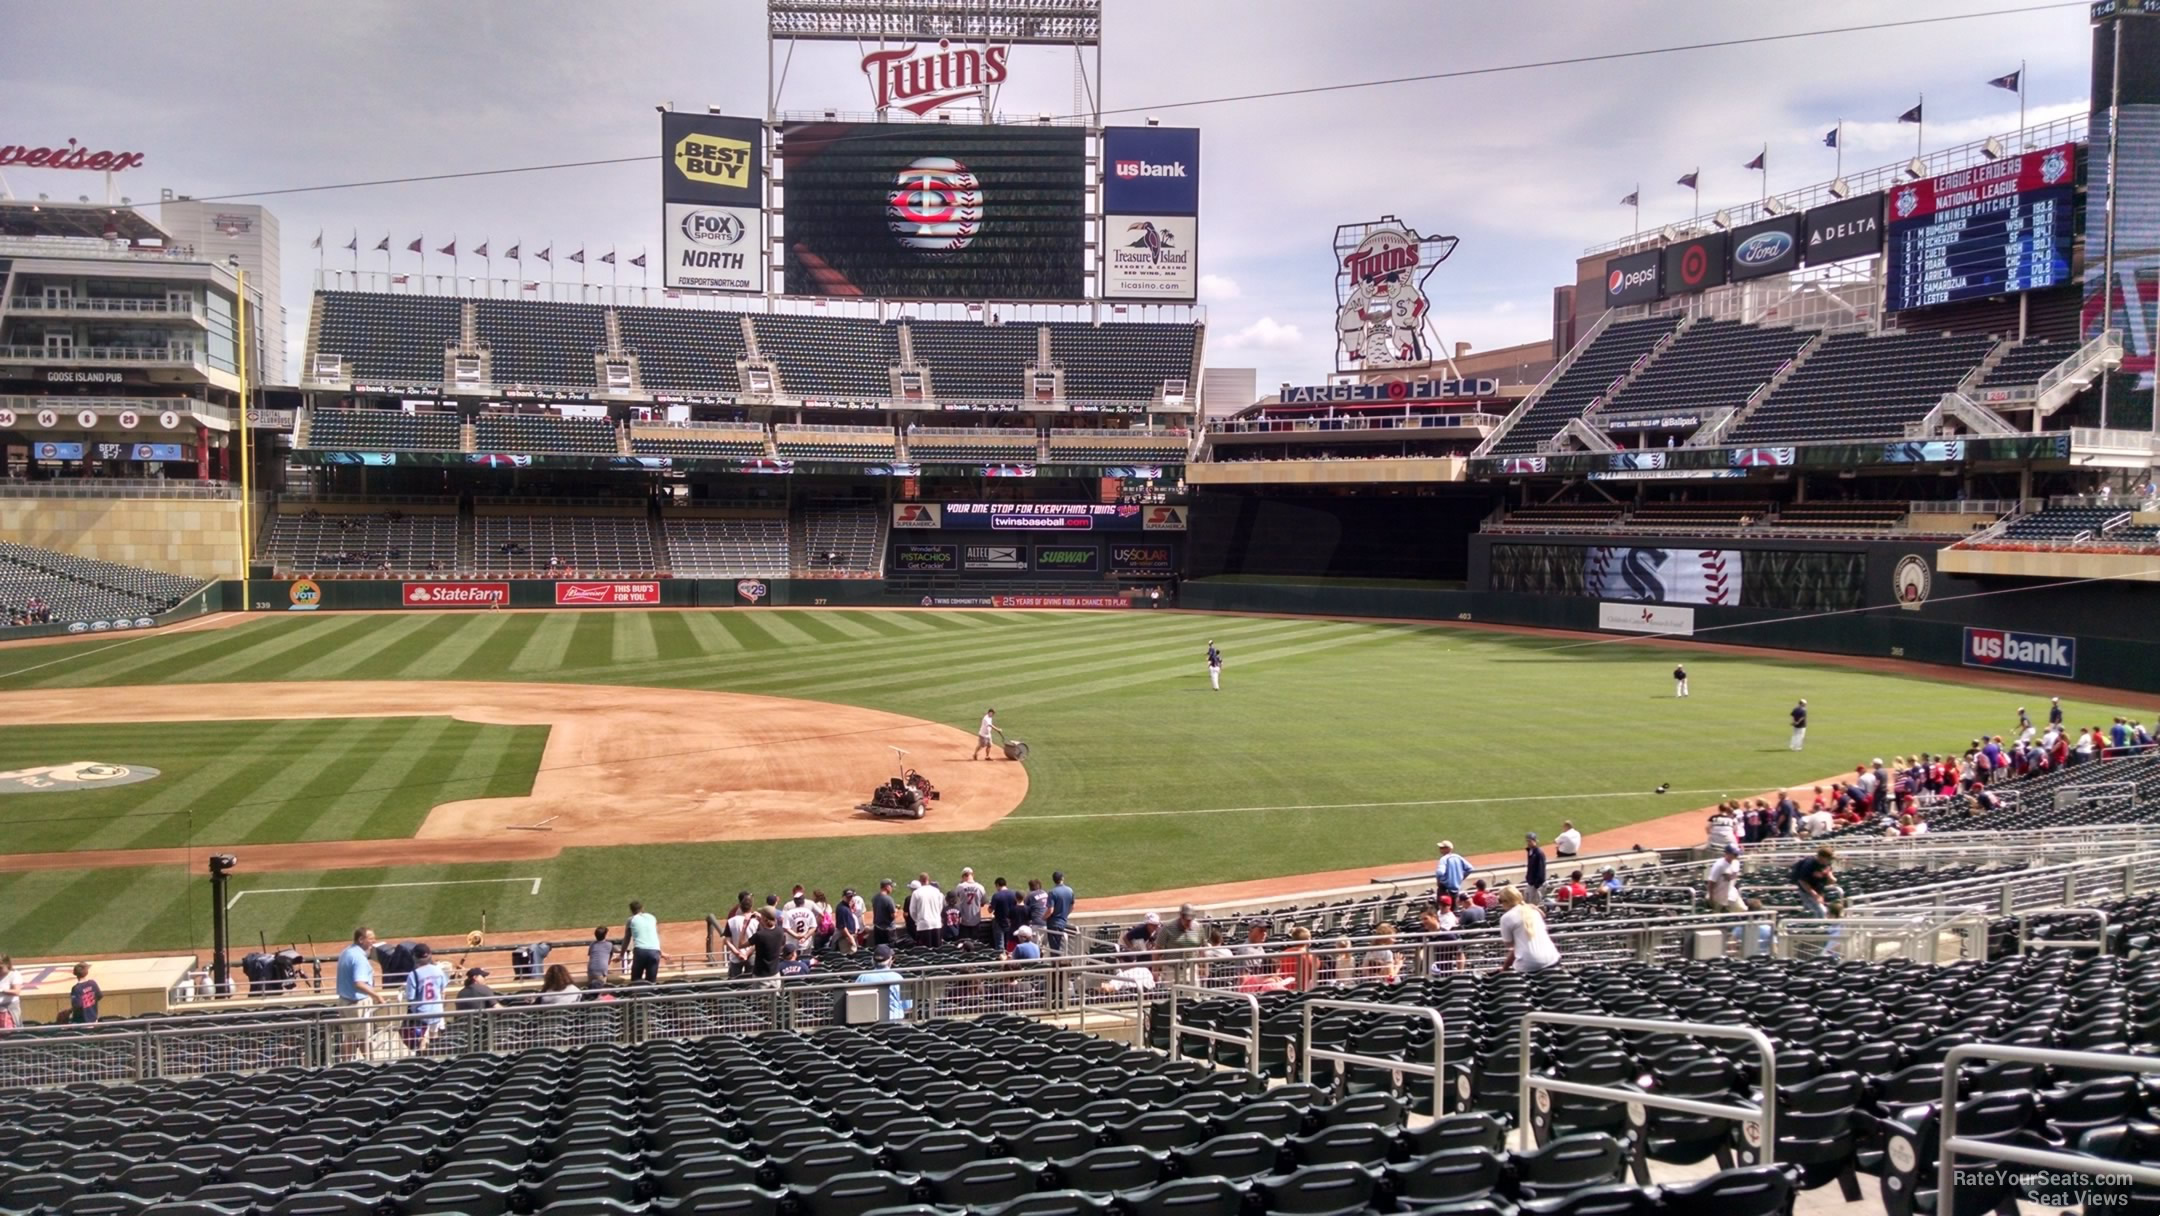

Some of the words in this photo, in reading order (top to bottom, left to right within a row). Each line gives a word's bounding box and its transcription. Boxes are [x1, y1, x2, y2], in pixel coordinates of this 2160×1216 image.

[2092, 1, 2116, 16] 11:43
[861, 38, 1008, 113] Twins
[684, 141, 749, 164] BEST
[686, 158, 745, 180] BUY
[1116, 161, 1187, 177] usbank
[1934, 170, 1972, 192] LEAGUE
[1974, 158, 2022, 183] LEADERS
[1936, 188, 1979, 210] NATIONAL
[1982, 178, 2018, 199] LEAGUE
[1934, 204, 1972, 224] INNINGS
[1975, 195, 2019, 216] PITCHED
[694, 216, 730, 234] FOX
[1826, 216, 1876, 241] DELTA
[1908, 232, 1910, 240] 1
[1918, 228, 1924, 238] M
[1926, 219, 1966, 236] BUMGARNER
[2010, 206, 2020, 219] SF
[694, 232, 732, 241] SPORTS
[1906, 242, 1911, 252] 2
[1918, 240, 1923, 249] M
[1925, 232, 1959, 248] SCHERZER
[2006, 218, 2024, 232] WSH
[1113, 249, 1151, 263] Treasure
[1160, 250, 1187, 263] Island
[1746, 236, 1782, 260] Ford
[1906, 254, 1910, 263] 3
[1918, 250, 1922, 260] J
[1925, 246, 1946, 259] CUETO
[2009, 231, 2019, 243] SF
[1917, 261, 1922, 272] T
[1925, 257, 1947, 270] ROARK
[2005, 242, 2023, 255] WSH
[682, 250, 744, 269] NORTH
[1344, 244, 1419, 287] Twins
[1625, 265, 1656, 290] pepsi
[1905, 276, 1910, 285] 5
[1917, 274, 1921, 283] J
[1924, 268, 1952, 282] ARRIETA
[2006, 255, 2020, 267] CHC
[678, 276, 750, 288] FOXSPORTSNORTH.COM
[1905, 287, 1909, 296] 6
[1916, 285, 1921, 294] J
[1924, 277, 1967, 293] SAMARDZIJA
[2008, 268, 2018, 280] SF
[1904, 298, 1909, 308] 7
[1916, 296, 1921, 306] J
[1923, 291, 1949, 304] LESTER
[2005, 280, 2019, 292] CHC
[48, 371, 74, 381] GOOSE
[76, 372, 104, 382] ISLAND
[106, 373, 122, 382] PUB
[1280, 384, 1382, 402] TARGET
[1413, 378, 1498, 398] FIELD
[42, 414, 52, 423] 14
[166, 416, 172, 424] 3
[99, 444, 122, 452] SEPT.
[947, 504, 969, 513] YOUR
[971, 504, 989, 513] ONE
[990, 504, 1014, 513] STOP
[1015, 505, 1033, 514] FOR
[1034, 505, 1086, 514] EVERYTHING
[1089, 505, 1116, 514] TWINS
[995, 517, 1089, 526] twinsbaseball.com
[968, 547, 989, 558] ALTEC
[1040, 551, 1090, 563] SUBWAY
[1002, 597, 1015, 606] 25
[1973, 632, 2068, 666] usbank
[966, 893, 975, 905] 7
[797, 920, 804, 933] 2
[425, 982, 435, 1000] 6
